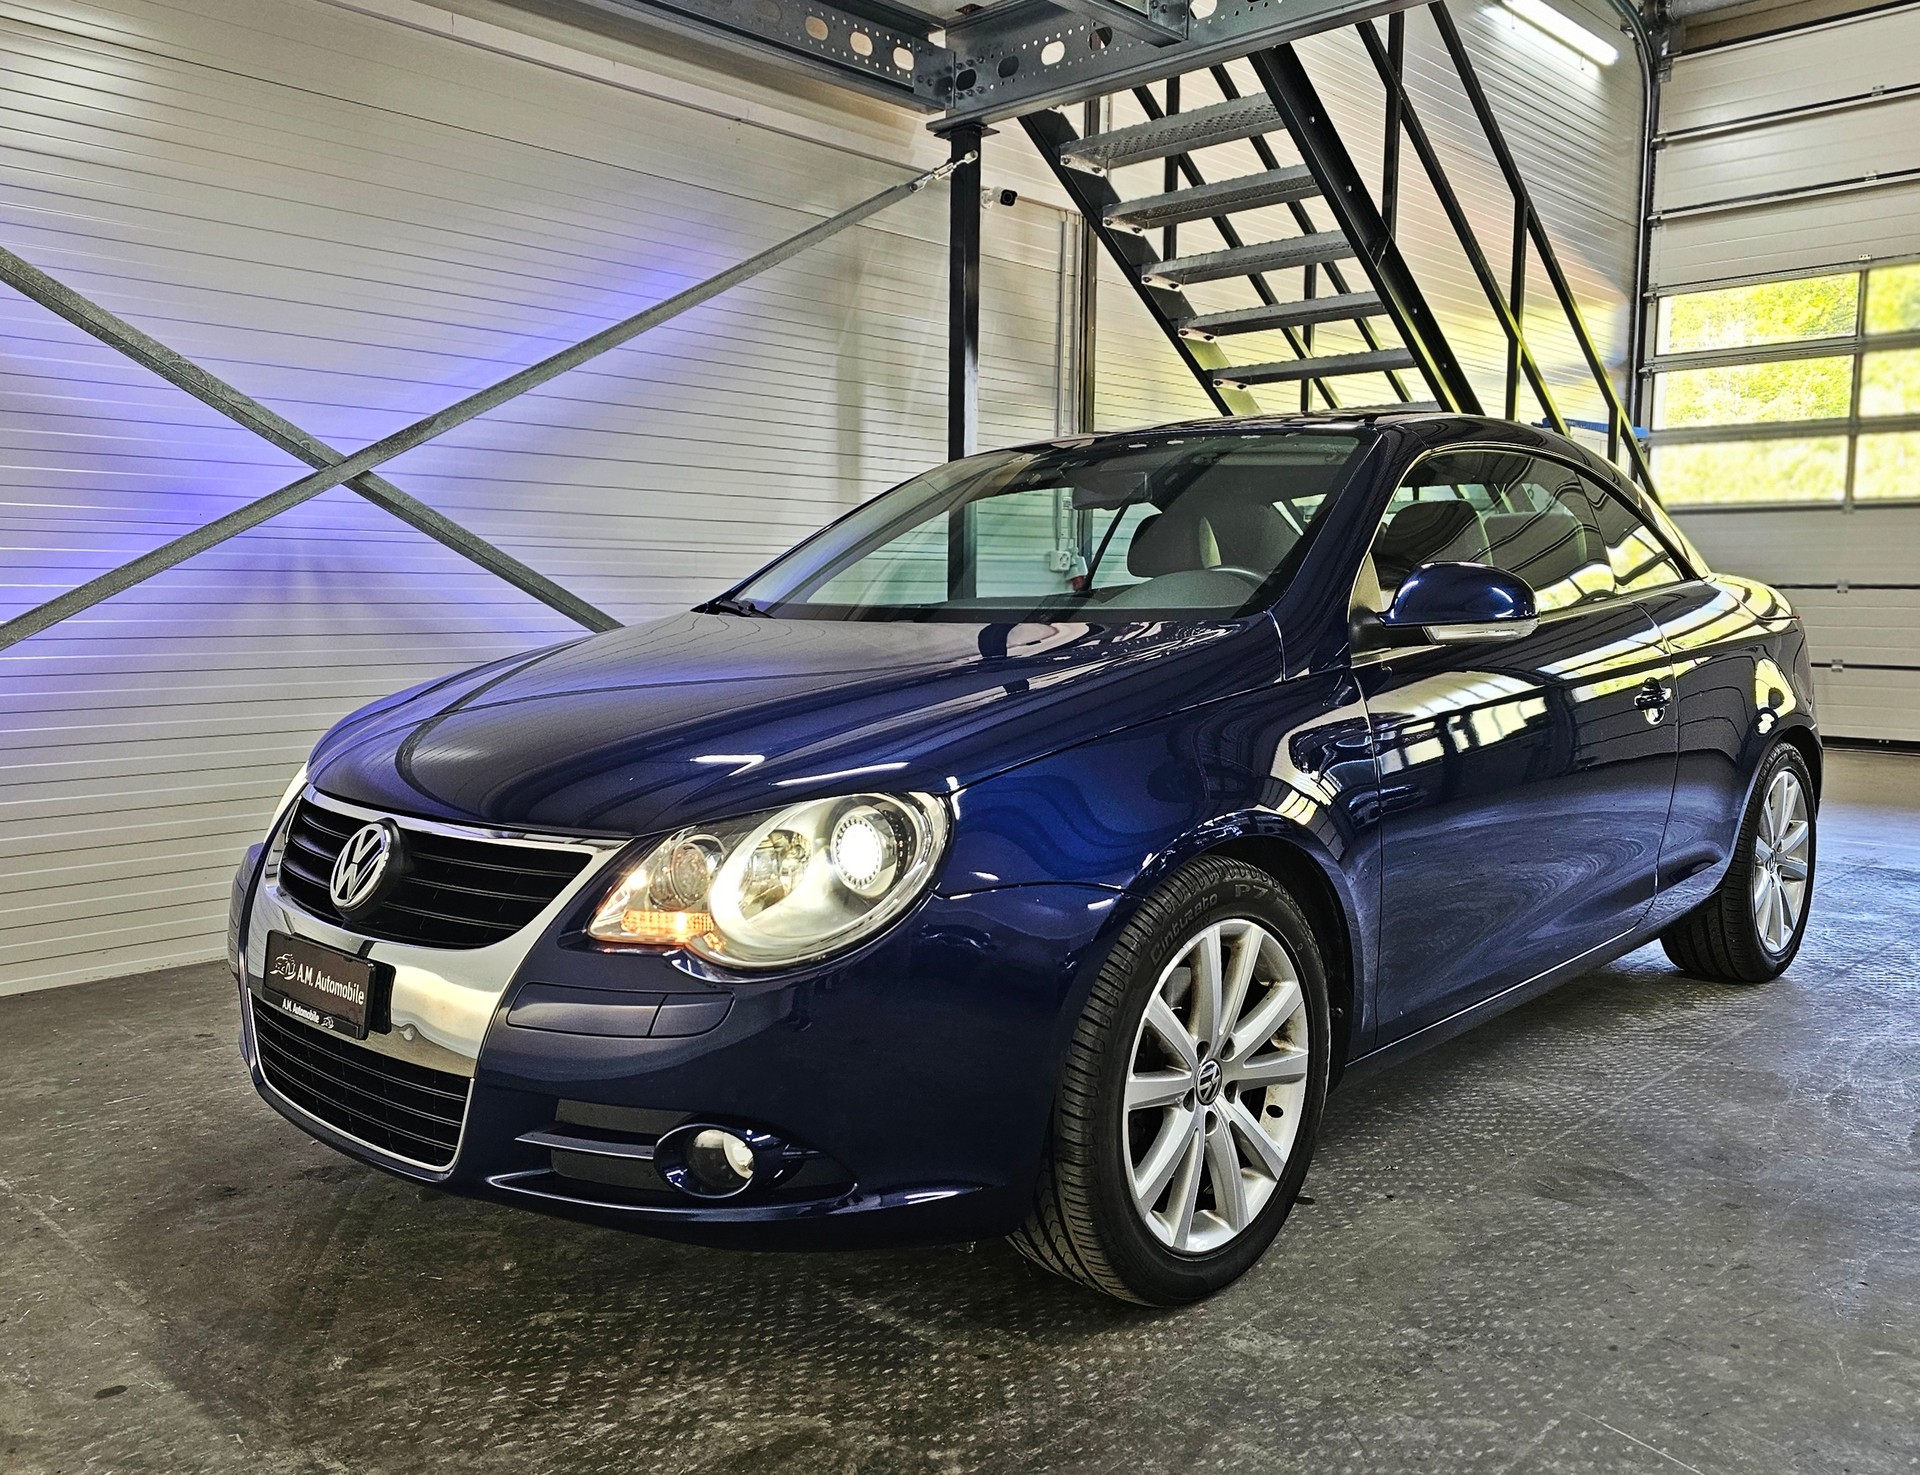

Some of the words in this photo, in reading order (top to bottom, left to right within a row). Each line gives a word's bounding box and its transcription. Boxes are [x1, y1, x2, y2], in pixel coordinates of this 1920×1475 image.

[331, 823, 390, 908] VW
[1234, 884, 1268, 900] P7
[297, 963, 313, 987] A.M.
[314, 971, 365, 1005] Automobile
[292, 1003, 320, 1023] Automobile
